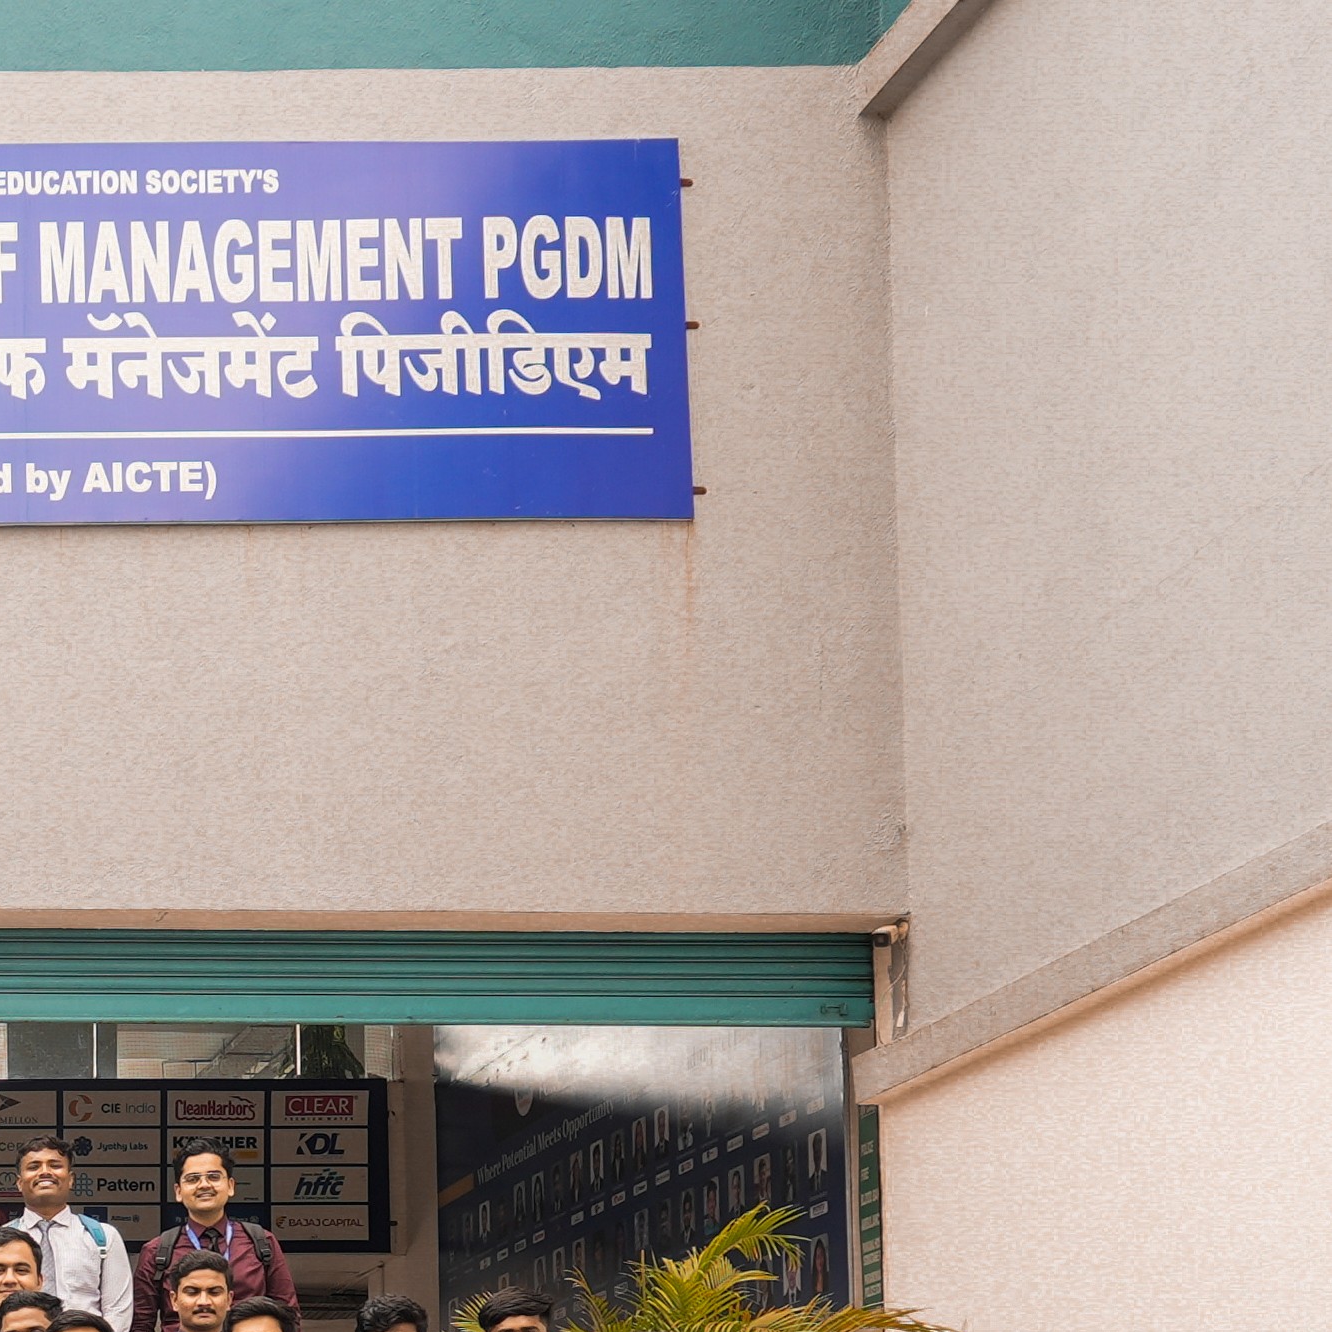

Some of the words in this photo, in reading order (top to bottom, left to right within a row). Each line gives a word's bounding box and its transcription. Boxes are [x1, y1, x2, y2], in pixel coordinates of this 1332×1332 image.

[146, 169, 279, 194] SOCIETY'S
[40, 218, 462, 303] MANAGEMENT
[483, 215, 652, 299] PGDM
[26, 463, 71, 500] by
[83, 461, 216, 499] AICTE)
[101, 1103, 121, 1113] CIE
[125, 1103, 156, 1114] India
[288, 1098, 350, 1114] CLEAR
[97, 1142, 128, 1153] Jyothy
[296, 1133, 345, 1155] KDL
[477, 1159, 503, 1185] Where
[501, 1134, 537, 1176] Potential
[537, 1126, 562, 1153] Meets
[562, 1099, 614, 1143] Opportunity
[97, 1178, 155, 1191] Pattern
[288, 1218, 320, 1228] BAJAJ
[322, 1218, 364, 1228] CAPITAL
